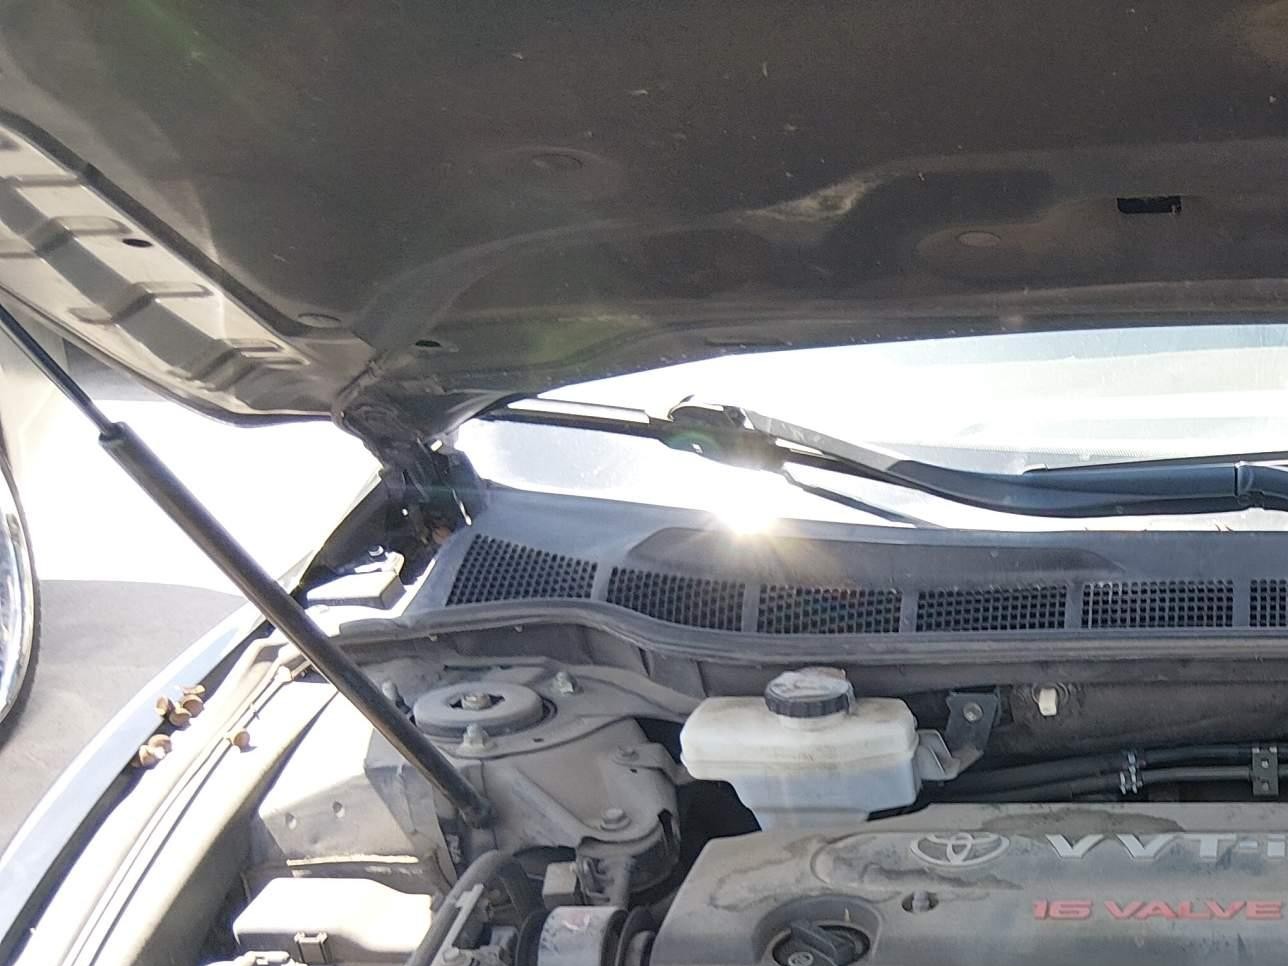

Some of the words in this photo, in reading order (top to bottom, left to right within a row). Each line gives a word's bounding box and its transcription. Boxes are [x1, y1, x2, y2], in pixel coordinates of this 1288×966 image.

[1044, 832, 1286, 860] VVT-i
[1033, 899, 1093, 920] 16
[1104, 899, 1284, 920] VALVE
